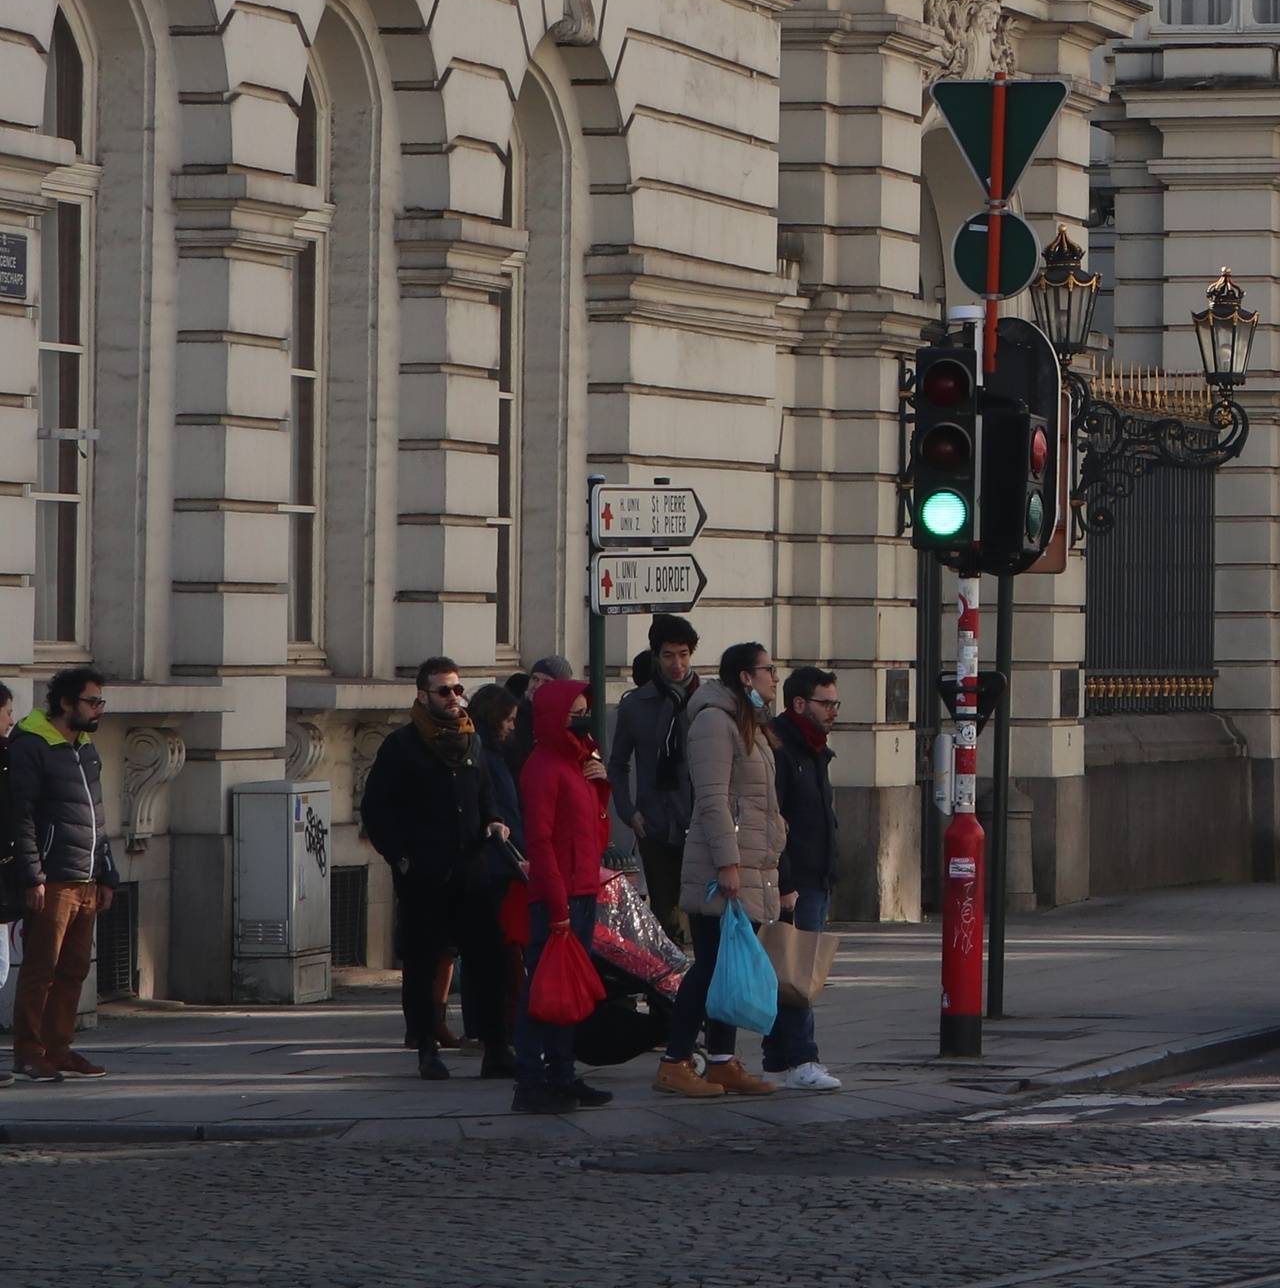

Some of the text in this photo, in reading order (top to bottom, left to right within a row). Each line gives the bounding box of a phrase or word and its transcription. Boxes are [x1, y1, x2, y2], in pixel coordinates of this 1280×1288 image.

[651, 495, 660, 513] St
[663, 495, 686, 513] PIERRE
[651, 515, 660, 533] St
[664, 515, 687, 533] PIETER
[644, 566, 654, 593] J.
[656, 566, 691, 593] BORDET
